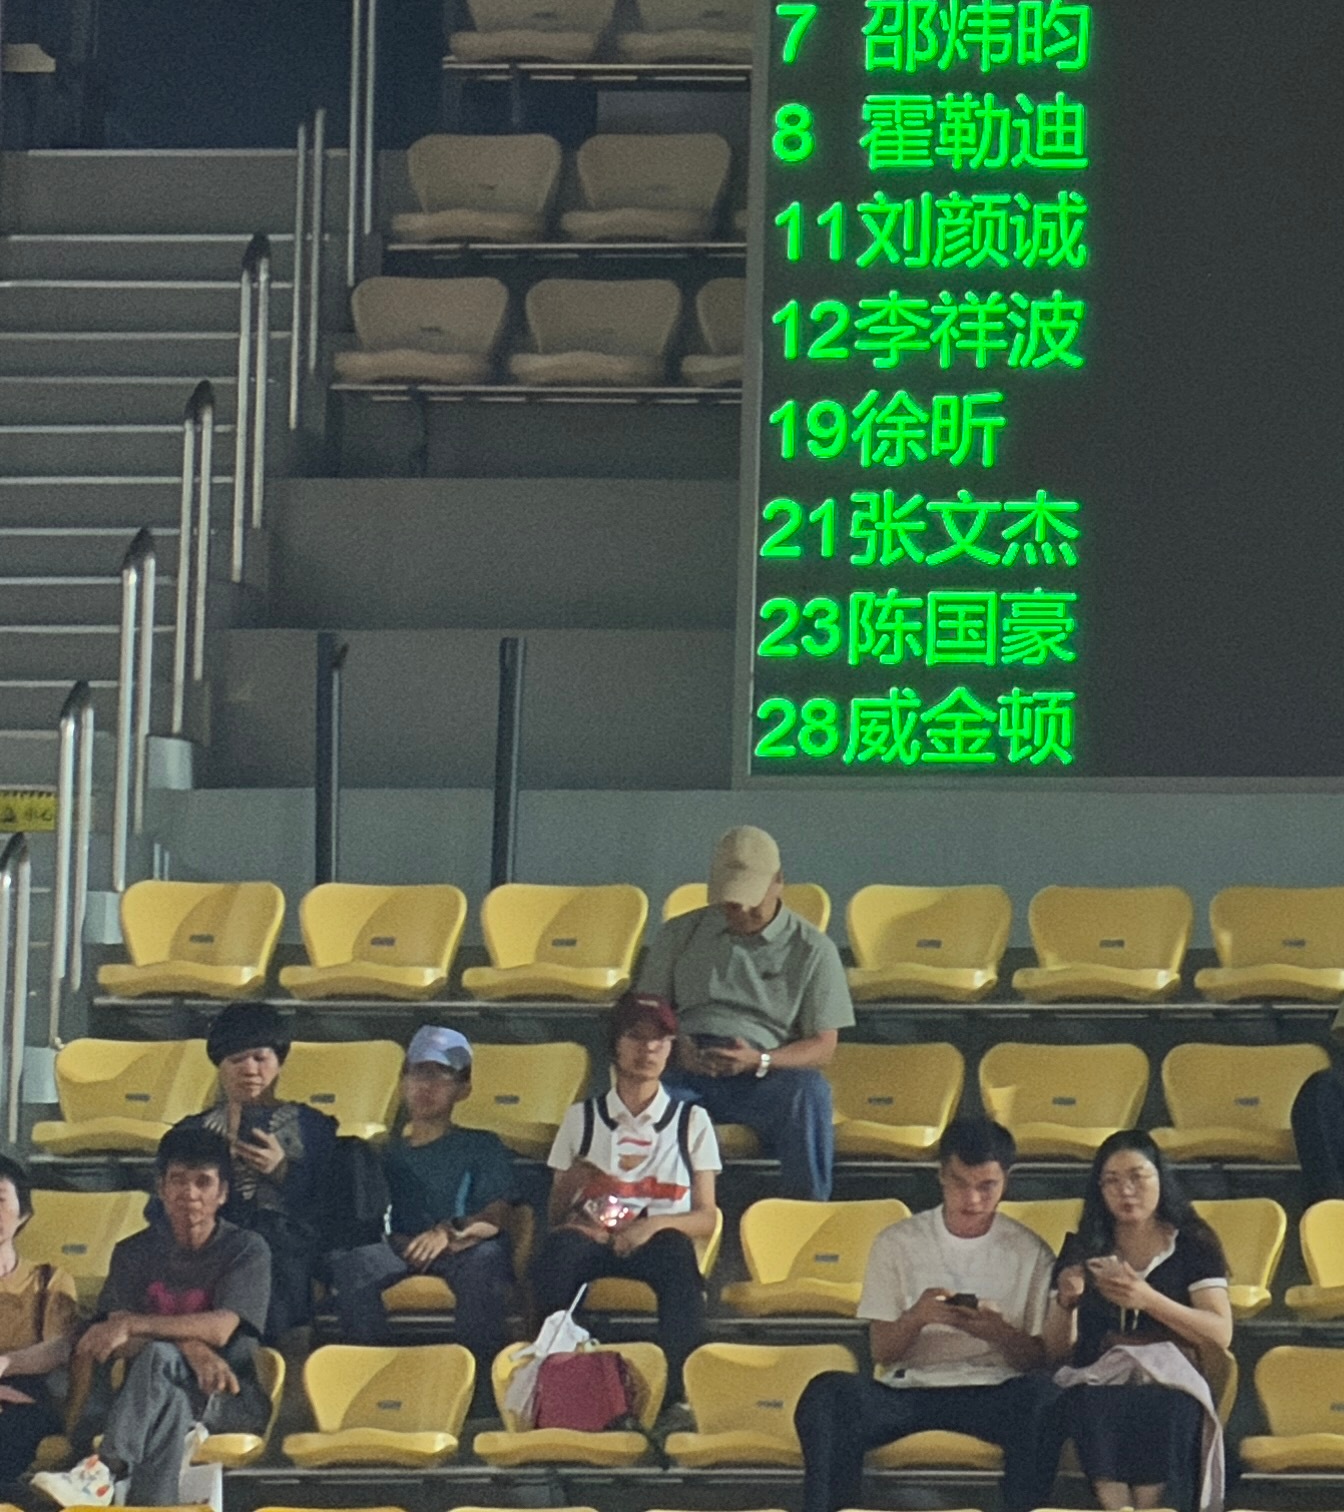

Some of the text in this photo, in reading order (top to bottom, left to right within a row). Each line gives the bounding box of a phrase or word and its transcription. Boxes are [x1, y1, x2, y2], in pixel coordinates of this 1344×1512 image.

[776, 4, 817, 63] 7
[772, 103, 814, 162] 8
[859, 91, 1088, 171] 霍勒迪
